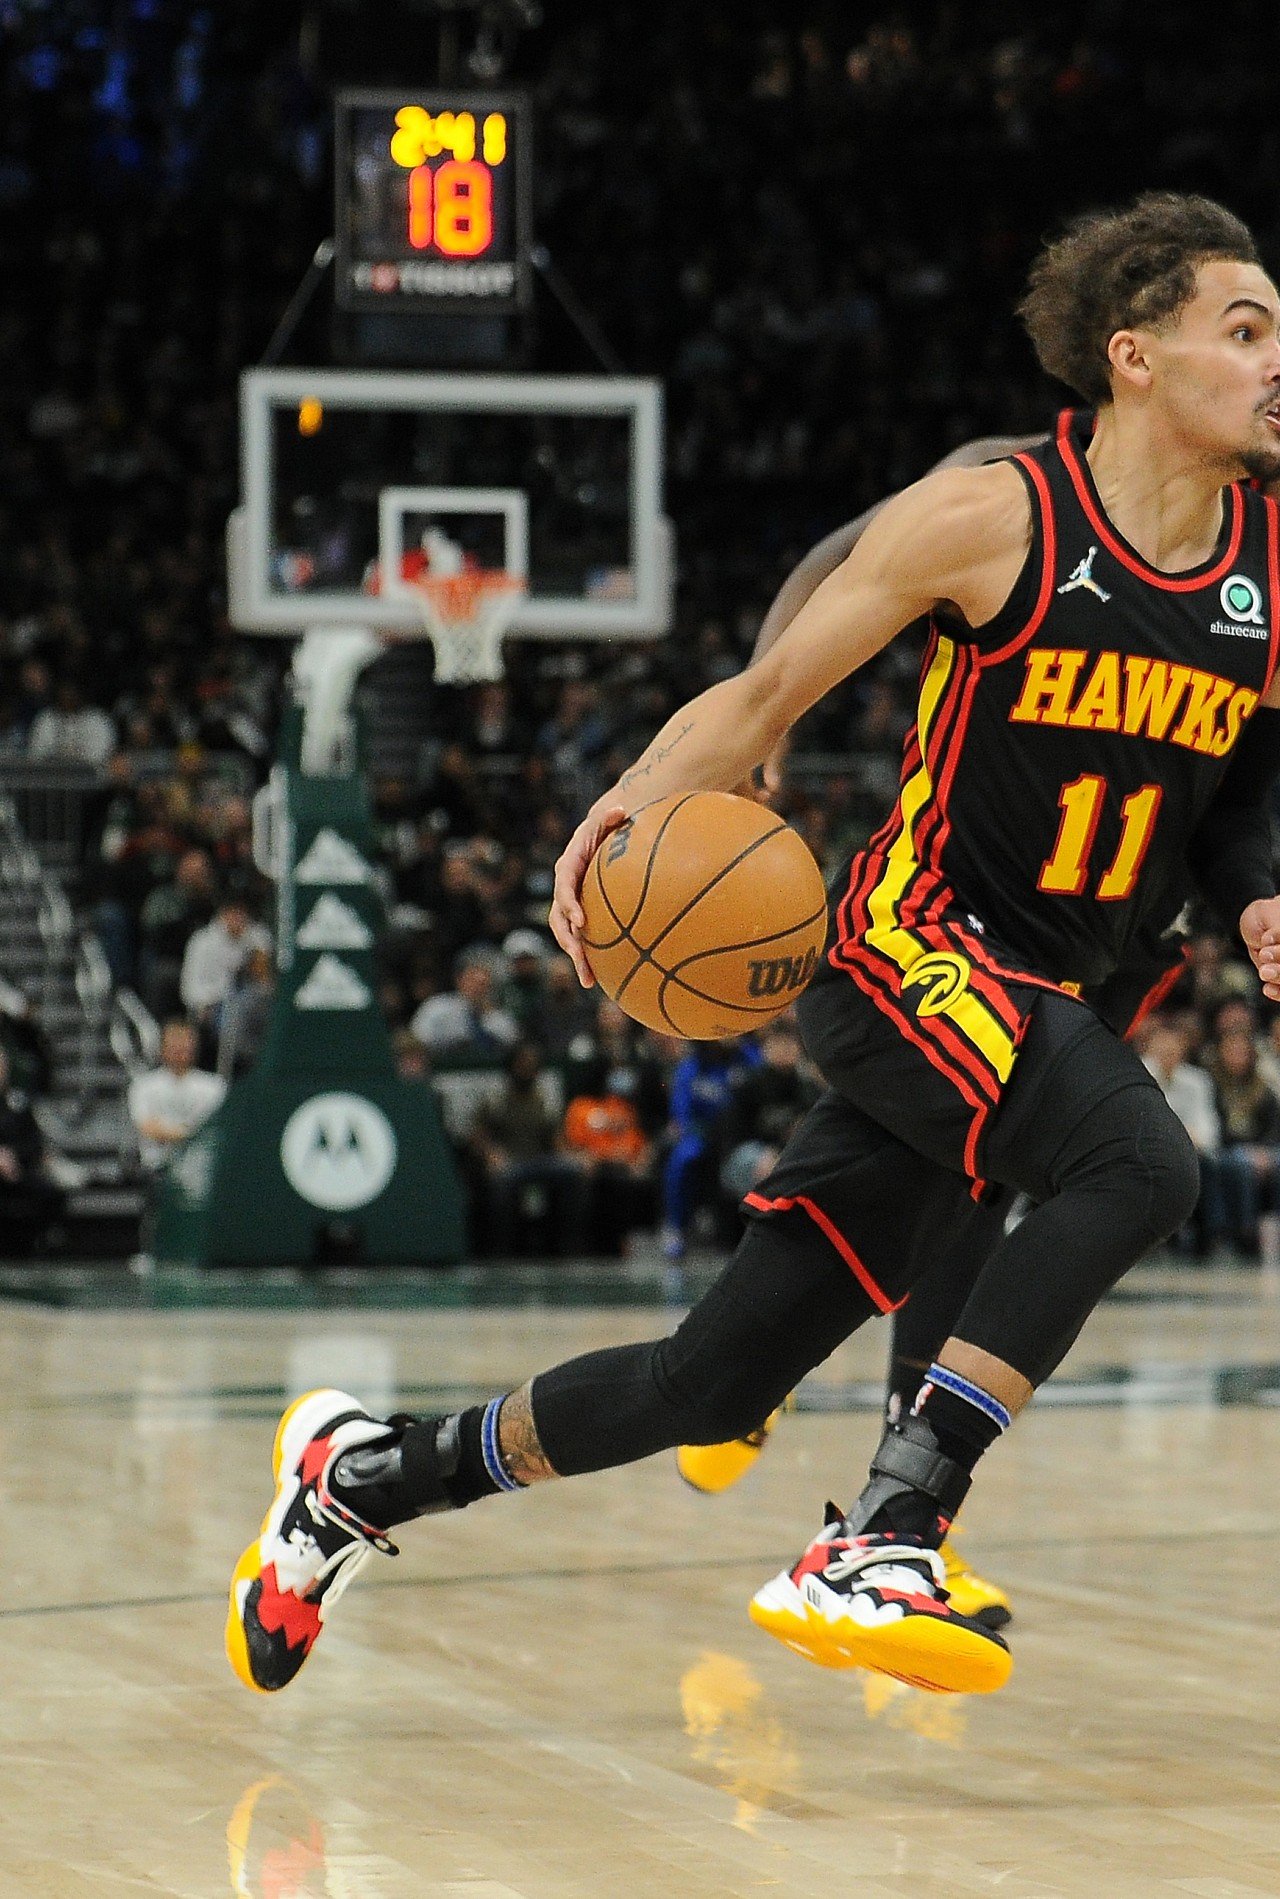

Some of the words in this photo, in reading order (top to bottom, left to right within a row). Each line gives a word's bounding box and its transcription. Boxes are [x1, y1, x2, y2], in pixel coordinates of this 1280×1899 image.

[408, 160, 492, 257] 18
[1209, 620, 1268, 640] sharecare
[1008, 648, 1262, 758] HAWKS
[1036, 772, 1164, 901] 11
